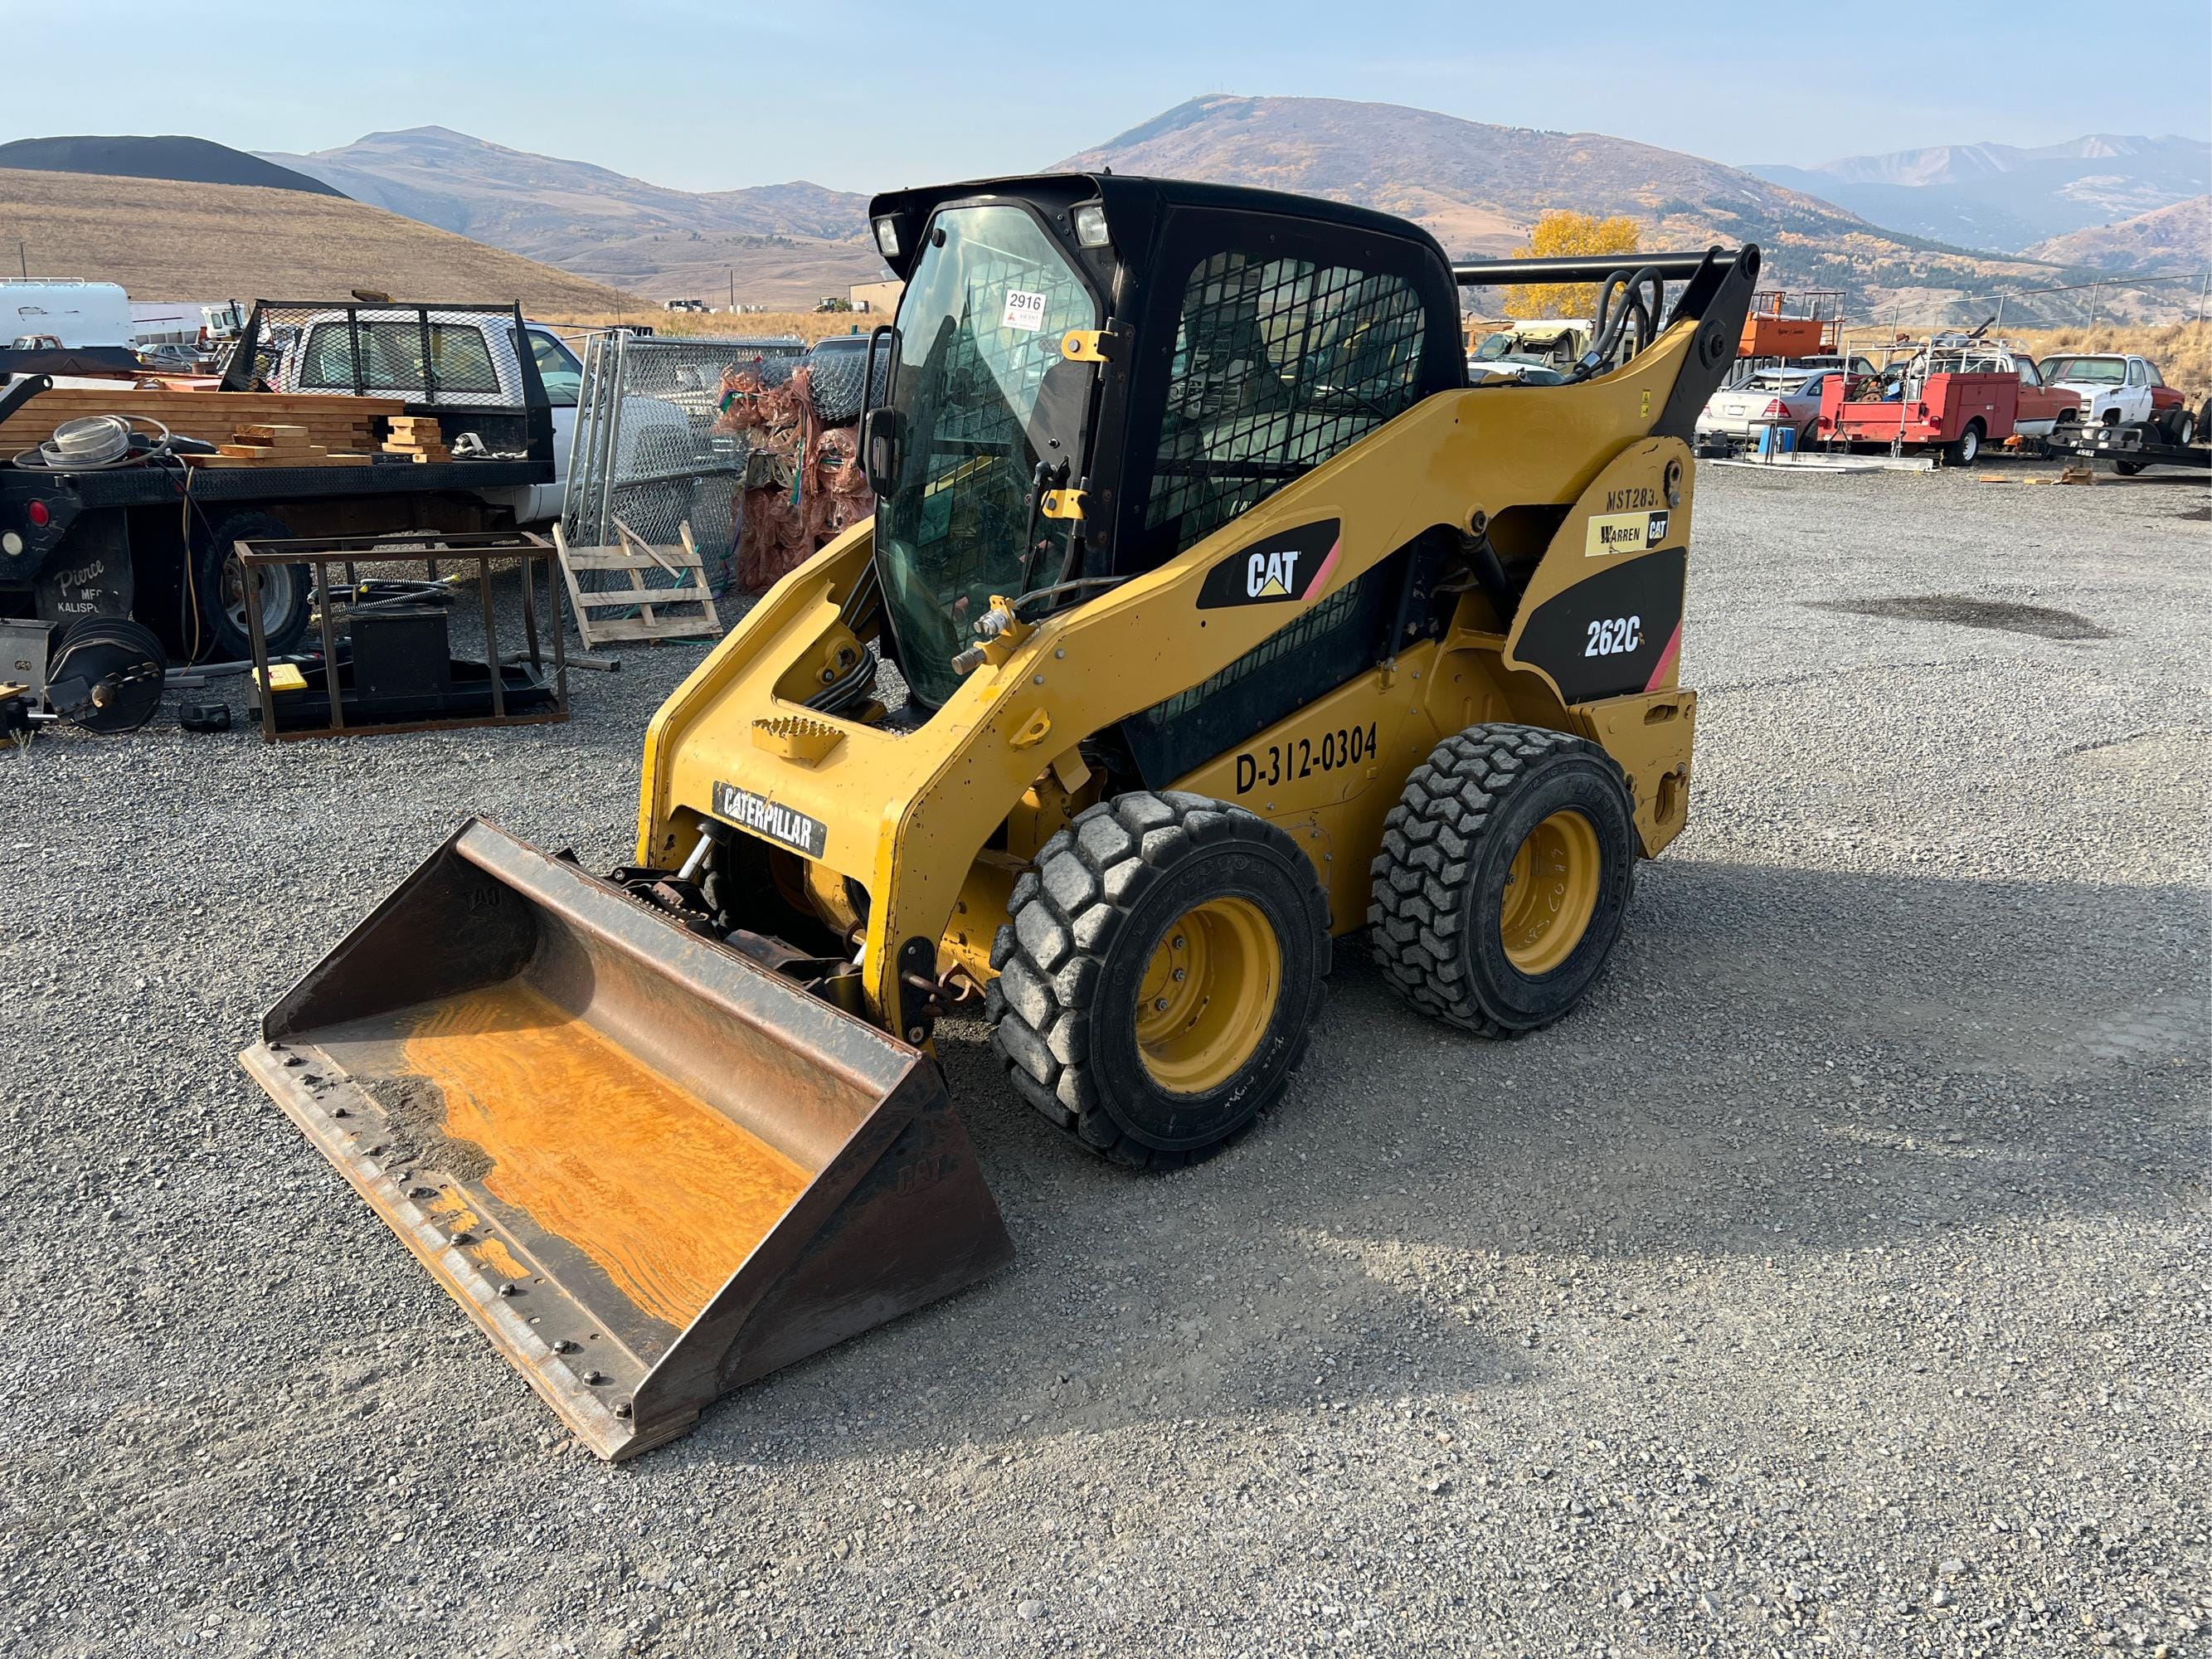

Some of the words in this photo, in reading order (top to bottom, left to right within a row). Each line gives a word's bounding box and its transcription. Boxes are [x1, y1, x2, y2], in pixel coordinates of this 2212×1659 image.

[1009, 294, 1041, 310] 2916
[1601, 525, 1640, 543] WARREN
[1649, 520, 1666, 539] CAT
[54, 560, 105, 596] Pierce
[1247, 551, 1298, 597] CAT
[1585, 615, 1641, 657] 262C
[1237, 722, 1376, 795] D-312-0304
[724, 787, 812, 851] CATERPILLAR
